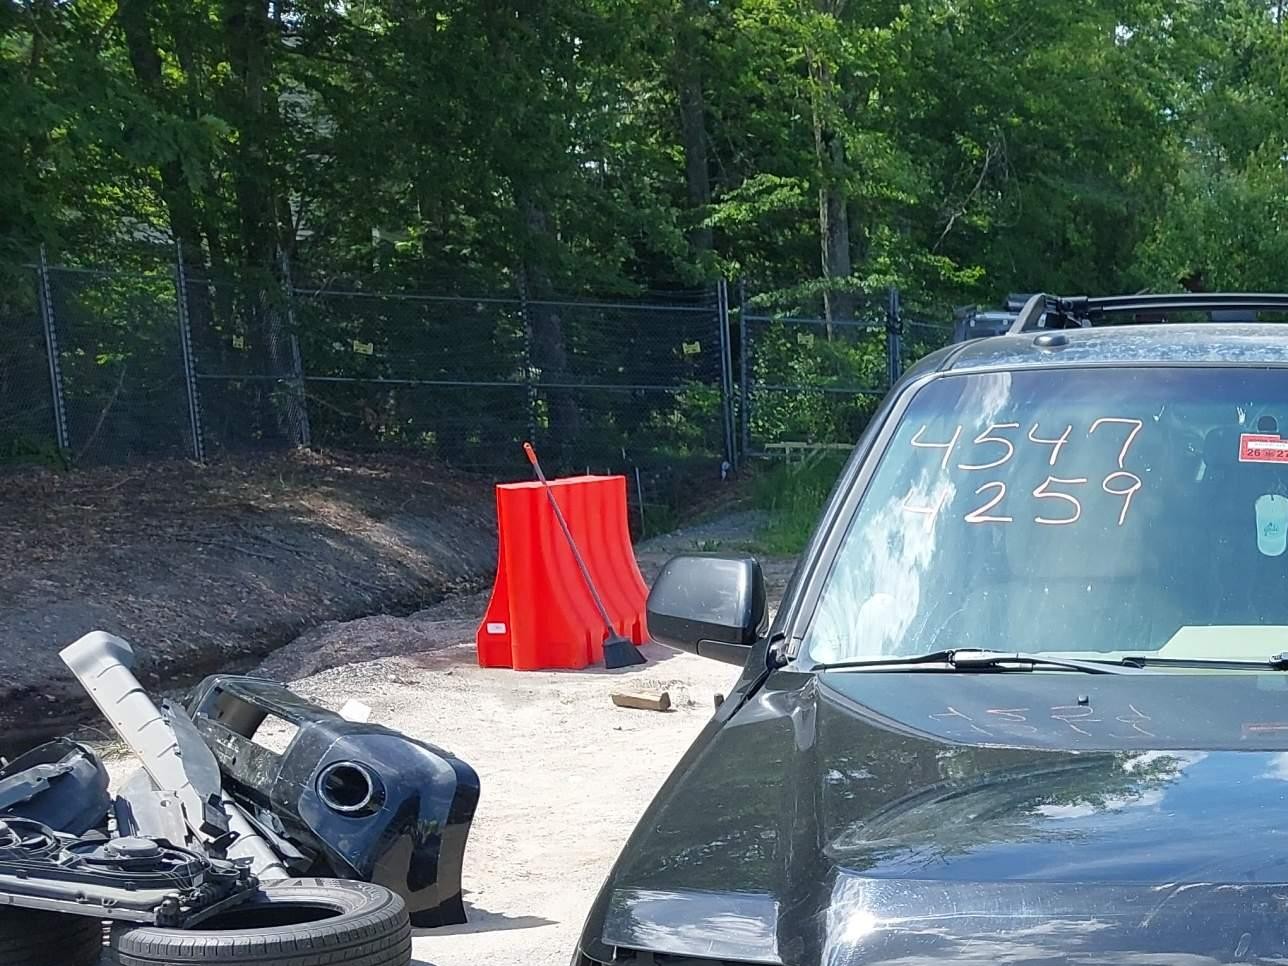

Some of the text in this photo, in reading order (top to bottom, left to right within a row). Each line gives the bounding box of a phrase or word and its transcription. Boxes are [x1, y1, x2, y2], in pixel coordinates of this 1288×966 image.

[911, 417, 1143, 469] 4547
[1247, 448, 1260, 457] 26
[903, 471, 1142, 533] 4259
